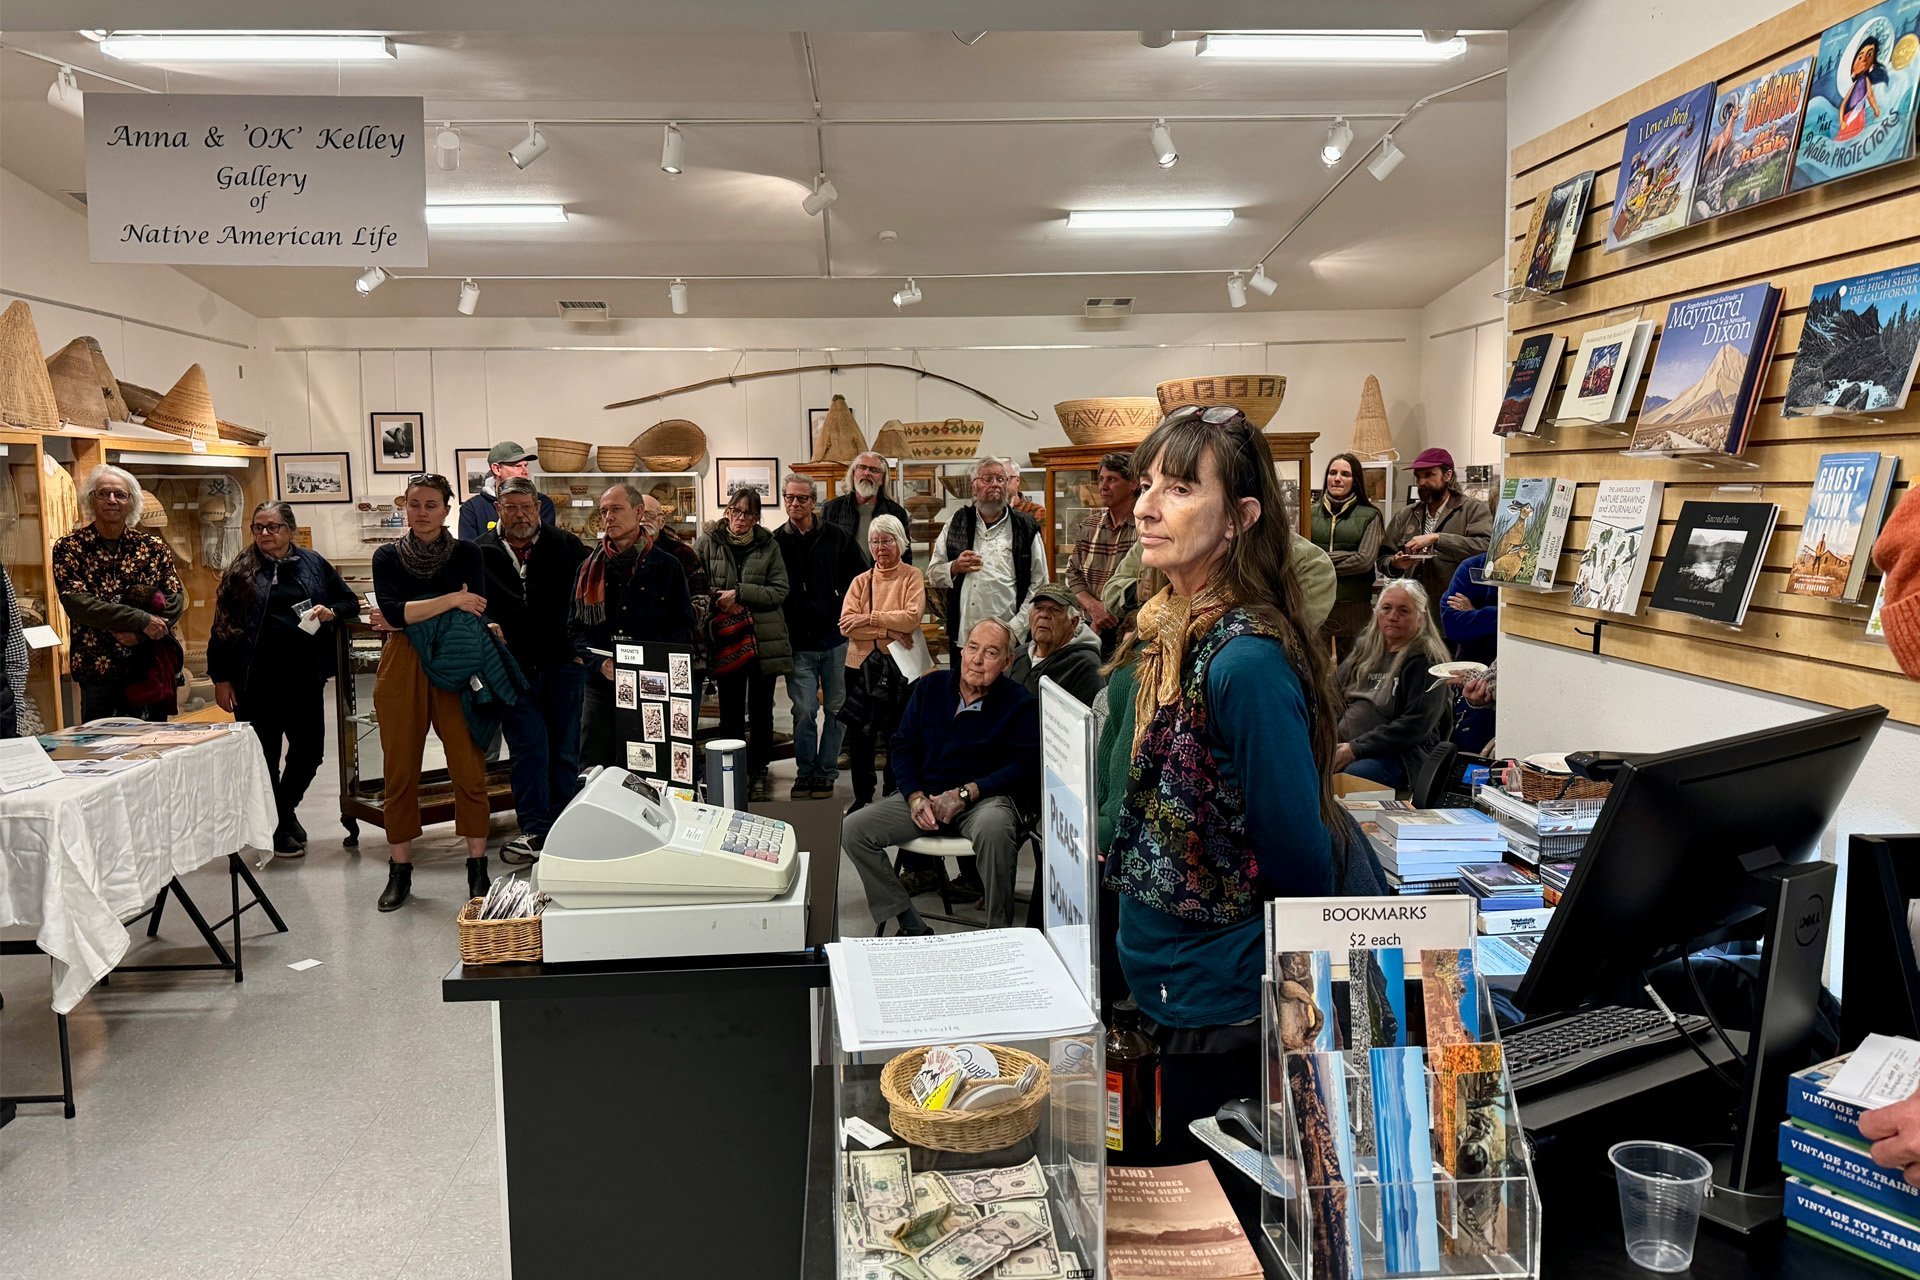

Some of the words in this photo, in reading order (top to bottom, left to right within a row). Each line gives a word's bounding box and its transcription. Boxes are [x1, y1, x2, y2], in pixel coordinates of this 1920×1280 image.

[1743, 70, 1804, 133] BIGHORNS
[1645, 122, 1663, 140] Love
[1663, 116, 1669, 128] a
[1817, 112, 1828, 124] WE
[1819, 120, 1833, 133] ARE
[107, 125, 190, 148] Anna
[204, 126, 225, 148] &
[316, 125, 406, 157] Kelley
[1740, 135, 1787, 163] honk
[1803, 131, 1832, 165] Water
[1830, 107, 1900, 168] PROTECTORS
[216, 165, 307, 195] Gallery
[250, 190, 271, 213] of
[120, 223, 210, 245] Native
[216, 225, 343, 246] American
[351, 225, 398, 253] Life
[1849, 284, 1866, 296] THE
[1867, 278, 1891, 293] HIGH
[1891, 272, 1920, 288] SIERR
[1850, 294, 1863, 306] OF
[1864, 285, 1918, 303] CALIFORNIA
[1668, 293, 1744, 330] Maynard
[1702, 321, 1751, 346] Dixon
[1818, 466, 1865, 491] GHOST
[1599, 494, 1619, 503] NATURE
[1619, 495, 1646, 504] DRAWING
[1608, 505, 1643, 514] JOURNALING
[1814, 493, 1853, 518] TOWN
[1705, 514, 1724, 523] Sacred
[1803, 519, 1850, 544] LIVING
[1050, 793, 1080, 867] PLEASE
[1323, 906, 1427, 921] BOOKMARKS
[1799, 911, 1821, 929] DELL
[1350, 932, 1366, 948] $2
[1371, 933, 1402, 946] each
[1801, 1091, 1854, 1116] VINTAGE
[1110, 1168, 1155, 1179] LAND!
[1790, 1139, 1842, 1166] VINTAGE
[1844, 1160, 1870, 1177] TOY
[1872, 1171, 1919, 1197] TRAINS
[1836, 1167, 1856, 1181] PIECE
[1857, 1175, 1882, 1191] PUZZLE
[1112, 1195, 1143, 1203] DEATH
[1147, 1195, 1188, 1203] VALLEY.
[1157, 1187, 1192, 1195] SIERRA
[1796, 1196, 1850, 1223] VINTAGE
[1853, 1218, 1879, 1235] TOY
[1881, 1230, 1920, 1253] TRAIN
[1844, 1225, 1865, 1239] PIECE
[1866, 1233, 1892, 1250] PUZZLE
[1108, 1249, 1138, 1257] poems
[1140, 1248, 1186, 1257] DOROTHY
